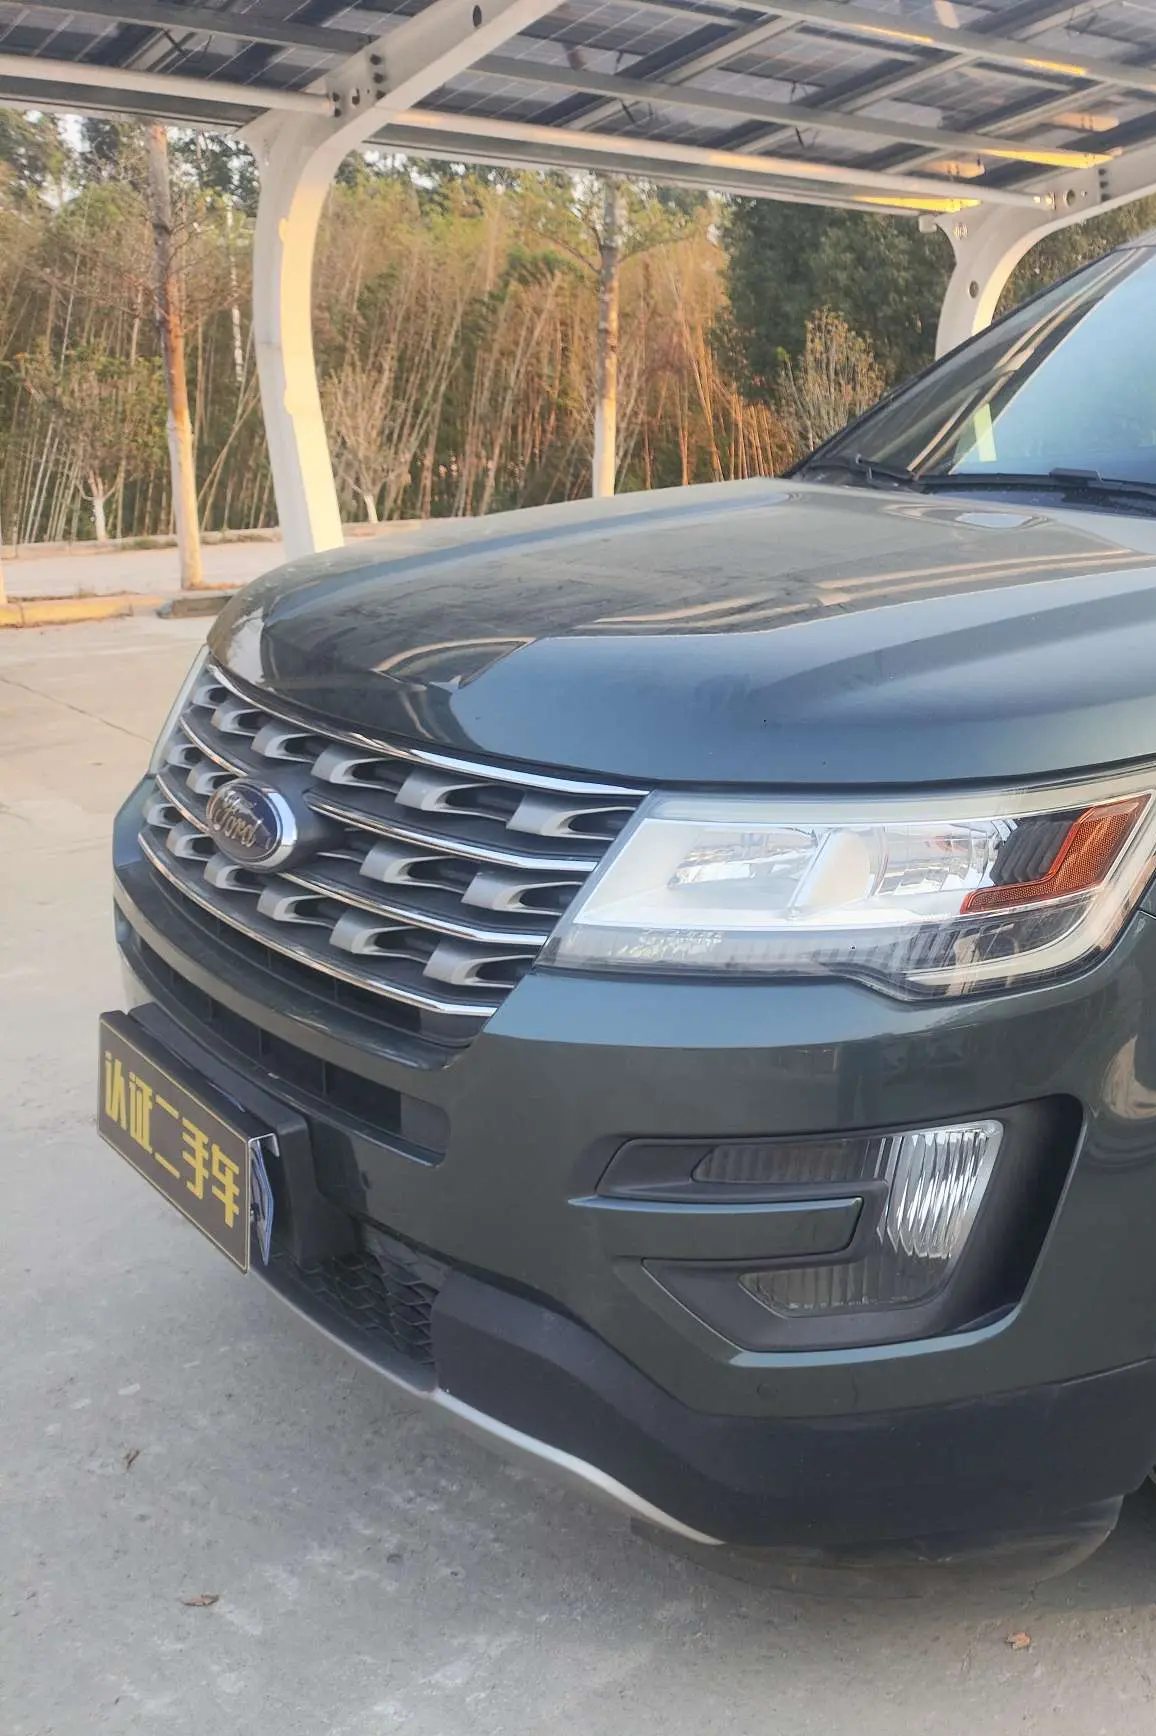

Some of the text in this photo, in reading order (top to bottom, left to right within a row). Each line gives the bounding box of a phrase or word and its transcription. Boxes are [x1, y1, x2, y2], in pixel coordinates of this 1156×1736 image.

[211, 789, 262, 849] Ford
[104, 1051, 240, 1229] 认证二手车
